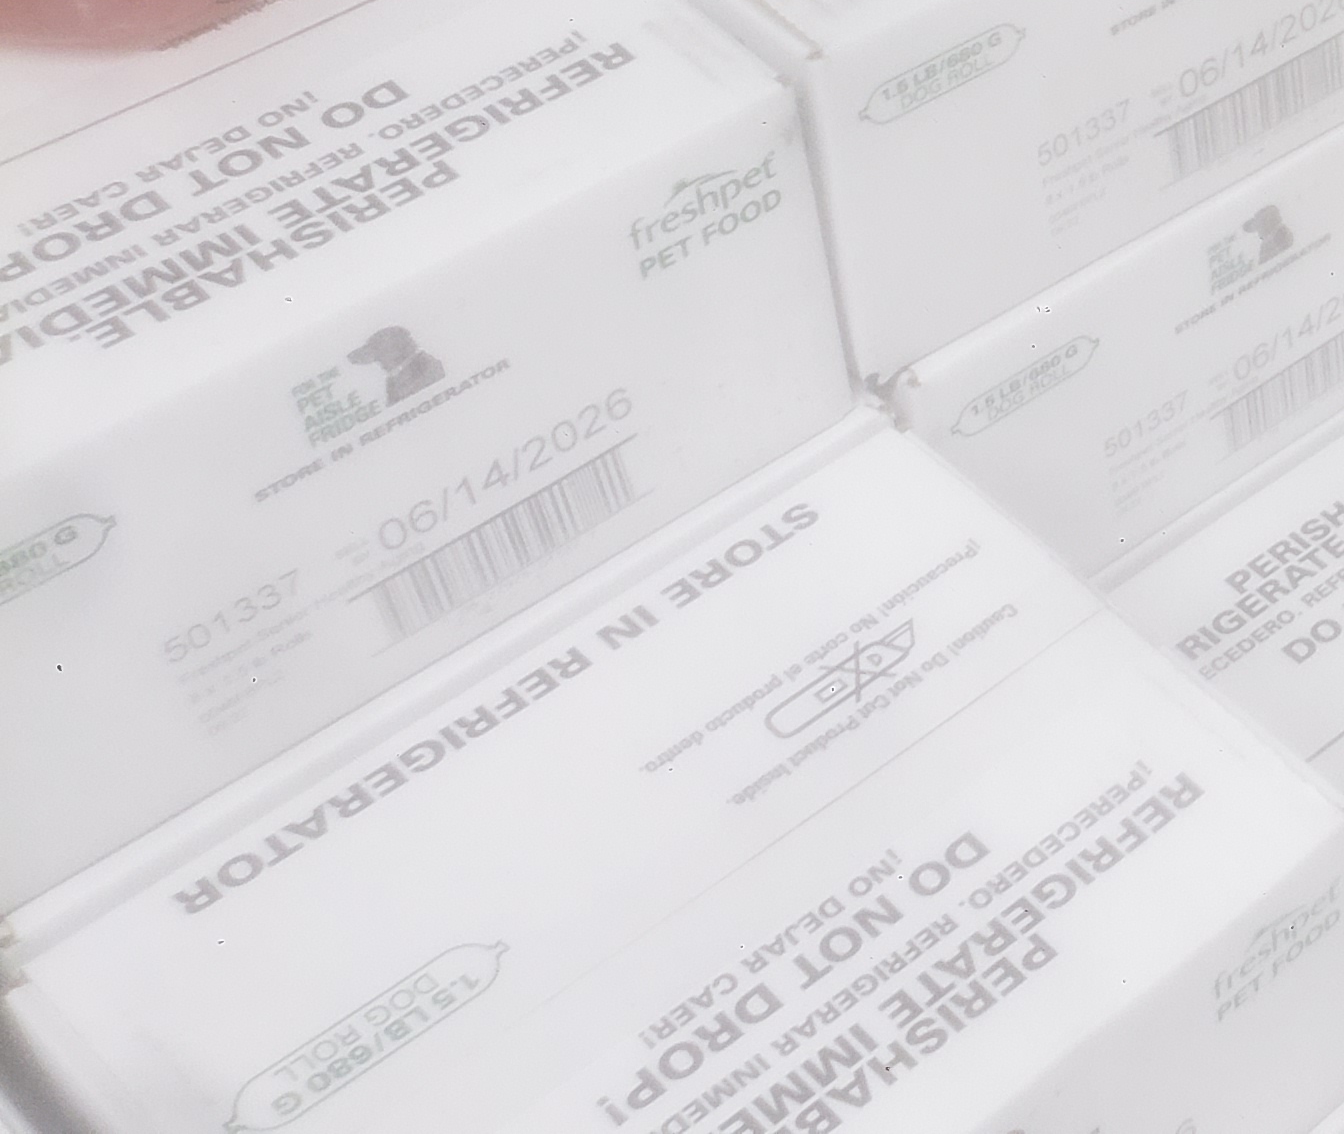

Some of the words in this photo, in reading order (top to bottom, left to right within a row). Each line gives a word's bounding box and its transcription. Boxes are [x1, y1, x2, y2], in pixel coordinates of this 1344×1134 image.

[1109, 5, 1157, 36] STORE
[368, 28, 587, 141] ¡PERECEDERO.
[882, 80, 910, 102] 1.5
[986, 32, 1004, 50] G
[899, 78, 943, 109] DOG
[945, 56, 998, 87] ROLL
[267, 42, 638, 230] REFRIGERATE
[320, 79, 410, 129] DO
[1036, 98, 1132, 168] 501337
[135, 126, 252, 184] DEJAR
[188, 126, 311, 197] NOT
[16, 180, 130, 237] CAER!
[150, 142, 365, 247] REFRIGERAR
[628, 150, 778, 250] freshpet
[0, 190, 172, 283] DROP
[67, 159, 460, 349] PERISHABLE.
[638, 235, 692, 281] PET
[702, 189, 783, 247] FOOD
[253, 463, 325, 504] STORE
[330, 444, 354, 462] IN
[358, 358, 512, 449] REFRIGERATOR
[295, 384, 335, 415] PET
[302, 392, 362, 433] AISLE
[307, 399, 384, 448] FRIDGE
[1103, 388, 1191, 459] 501337
[161, 568, 300, 665] 501337
[376, 386, 634, 554] 06/14/2026
[660, 501, 821, 611] STORE
[596, 604, 661, 651] IN
[803, 629, 850, 665] corte
[848, 613, 881, 634] No
[951, 602, 1020, 657] Caution!
[1281, 616, 1343, 666] DO
[889, 669, 923, 696] Not
[919, 652, 950, 675] Do
[704, 673, 784, 733] producto
[861, 692, 892, 720] Cut
[792, 714, 862, 768] Product
[172, 646, 593, 916] REFRIGERATOR
[907, 829, 992, 896] DO
[956, 758, 1154, 913] ¡PERECEDERO.
[740, 895, 848, 977] DEJAR
[877, 771, 1206, 1031] REFRIGERATE
[798, 894, 904, 992] NOT
[1211, 876, 1344, 1000] freshpet
[1216, 986, 1267, 1023] PET
[1269, 907, 1342, 977] FOOD
[361, 971, 442, 1027] DOG
[432, 971, 482, 1013] 1.5
[636, 971, 740, 1051] CAER!
[770, 912, 961, 1057] REFRIGERAR
[273, 1024, 362, 1081] ROLL
[305, 1005, 433, 1096] LB/680
[596, 981, 785, 1128] DROP!
[790, 931, 1059, 1134] PERISHAB
[271, 1090, 303, 1117] G
